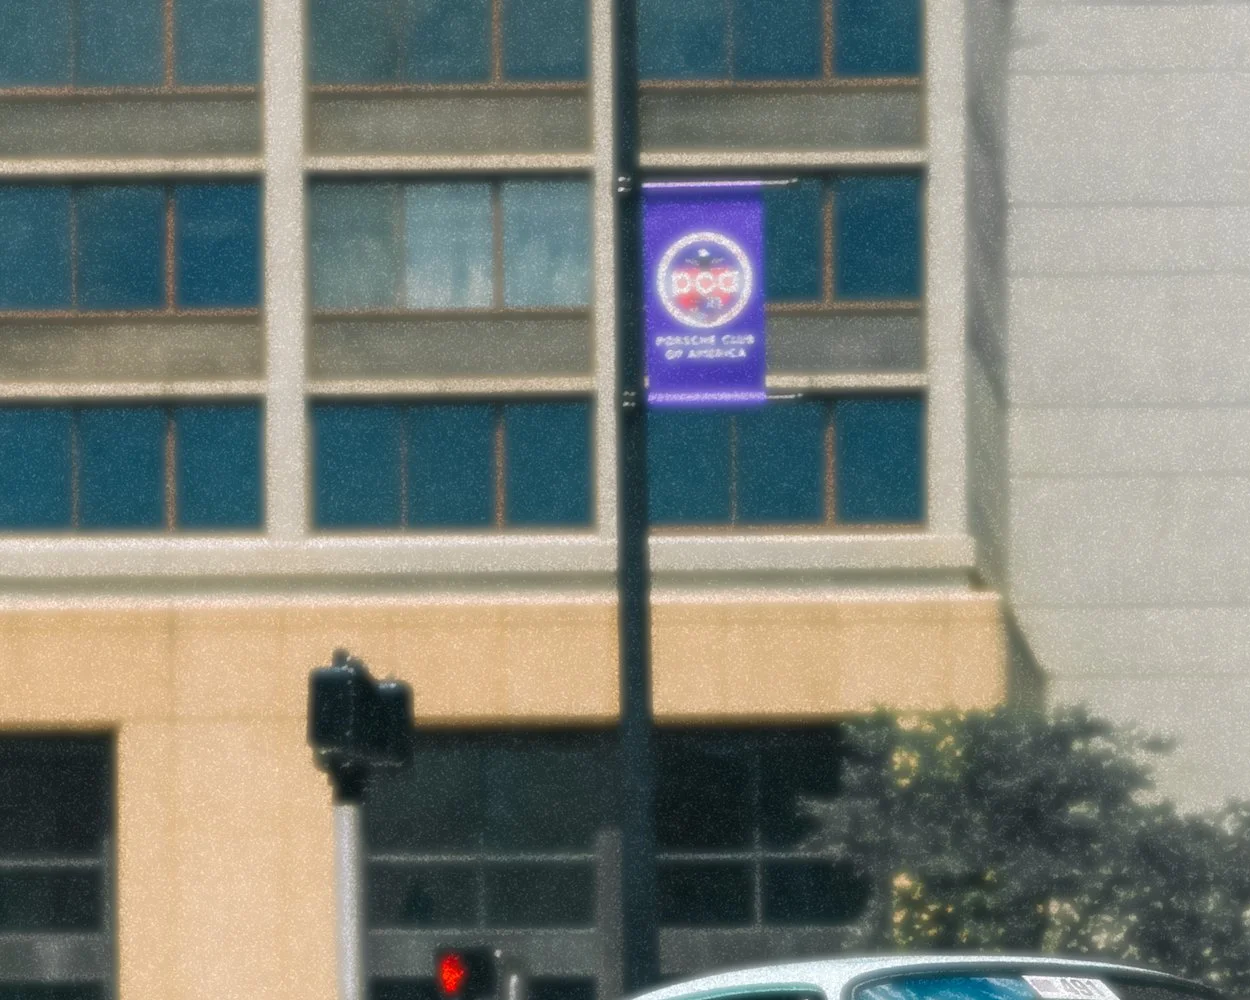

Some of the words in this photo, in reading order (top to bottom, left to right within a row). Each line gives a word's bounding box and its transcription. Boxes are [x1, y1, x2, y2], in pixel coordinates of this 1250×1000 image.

[655, 335, 716, 346] PORSCHE
[721, 334, 755, 345] CLUB
[665, 349, 683, 360] OF
[687, 348, 747, 358] AMERICA
[1060, 978, 1106, 997] 491
